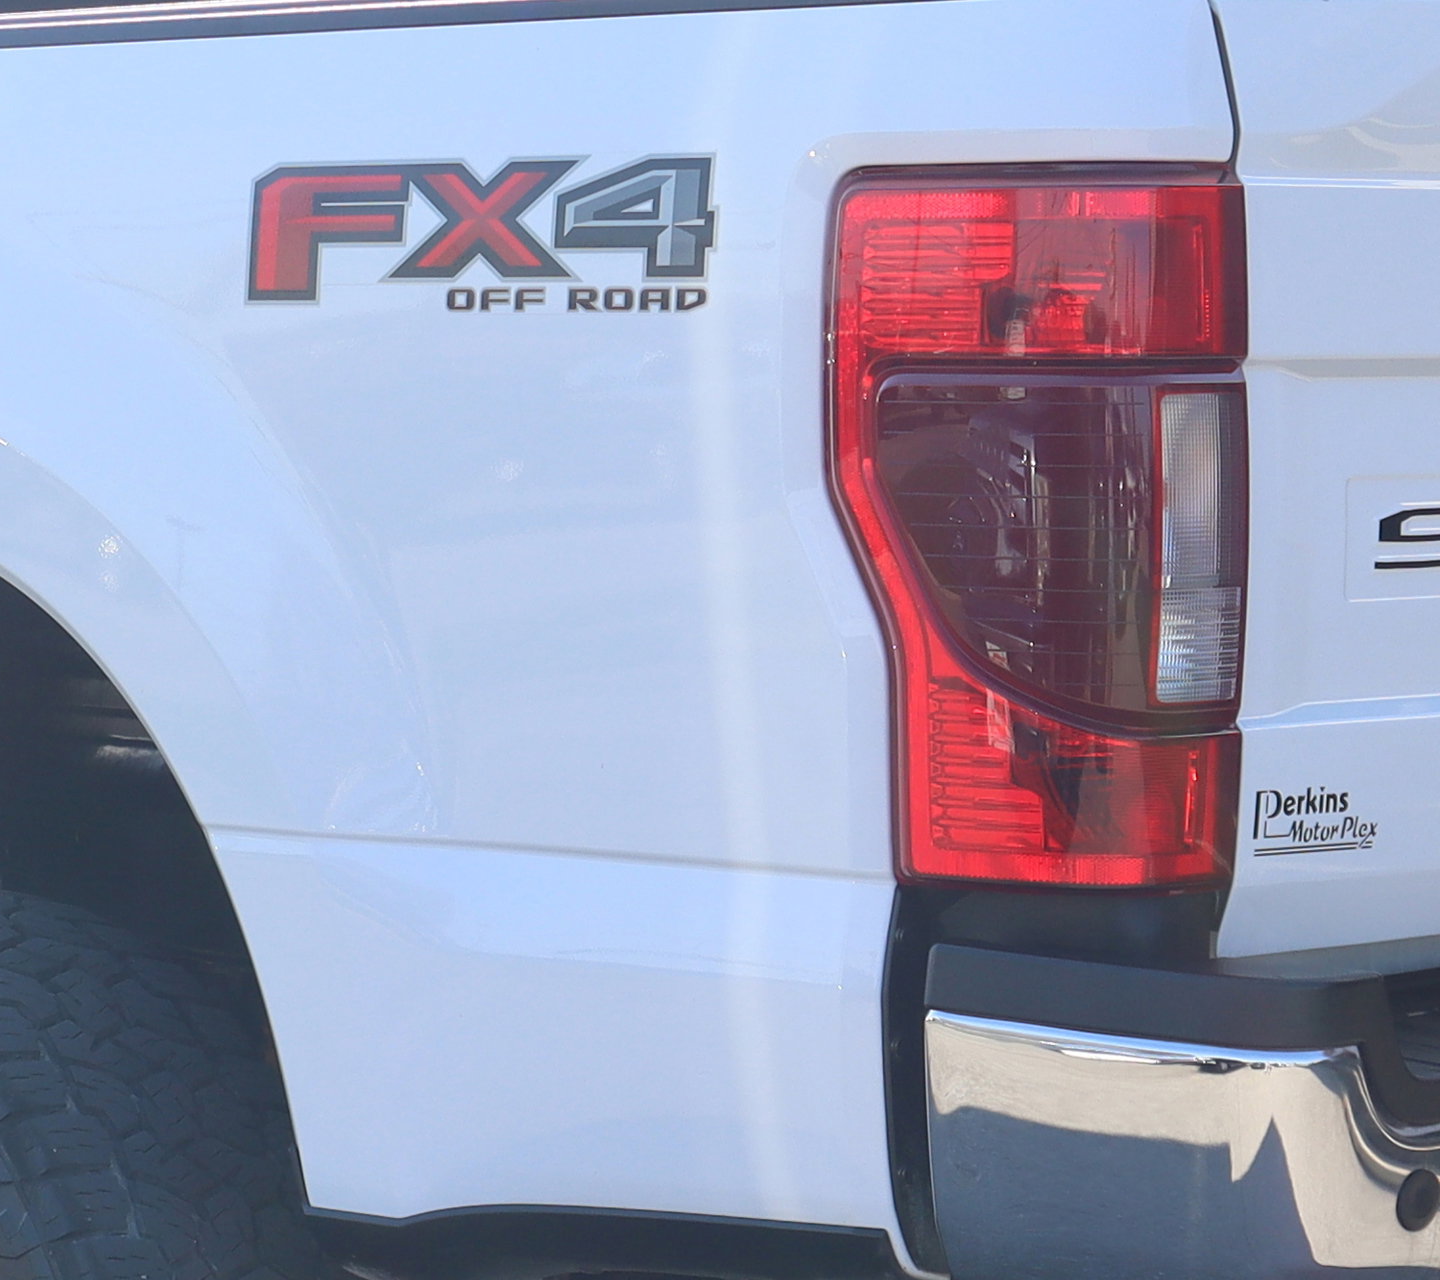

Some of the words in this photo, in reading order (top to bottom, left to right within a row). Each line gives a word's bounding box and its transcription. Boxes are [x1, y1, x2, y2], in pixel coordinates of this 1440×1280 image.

[245, 153, 719, 306] FX4
[445, 285, 547, 313] OFF
[566, 285, 709, 313] ROAD
[1252, 785, 1350, 841] Perkins
